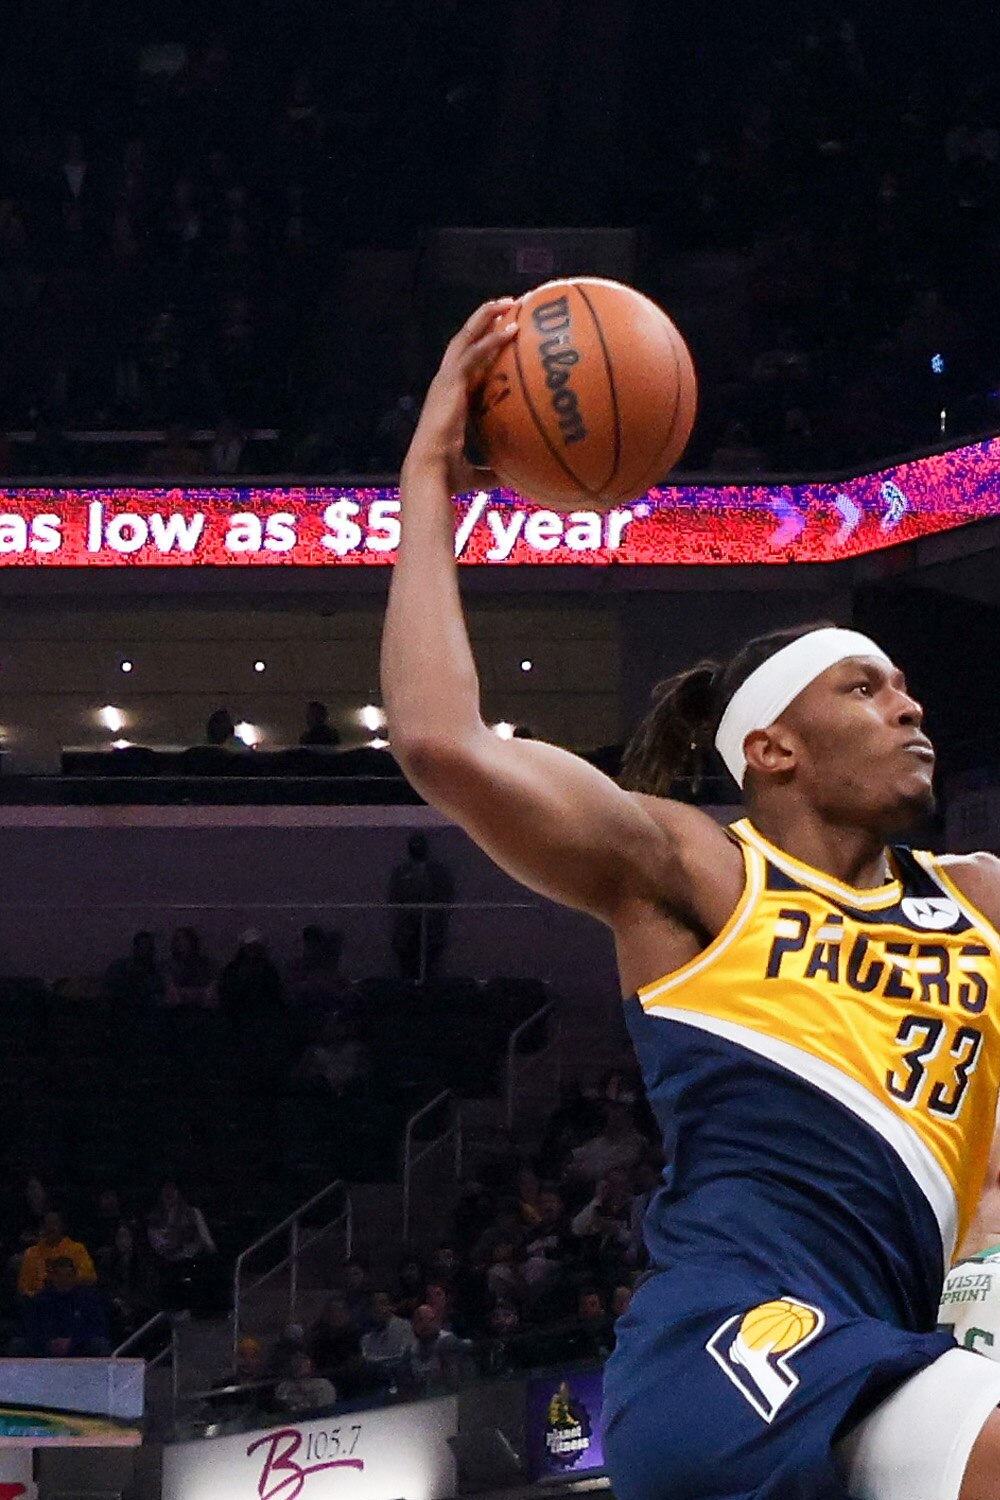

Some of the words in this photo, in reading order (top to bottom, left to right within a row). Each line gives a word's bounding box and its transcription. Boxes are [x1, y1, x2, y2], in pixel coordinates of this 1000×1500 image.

[531, 295, 588, 447] Wilson
[0, 512, 62, 554] as
[88, 500, 204, 554] low
[225, 512, 298, 554] as
[765, 909, 991, 1014] PACERS
[884, 1014, 984, 1121] 33
[940, 1287, 990, 1305] PRINT
[946, 1274, 993, 1292] VISTA
[306, 1425, 362, 1460] 105.7
